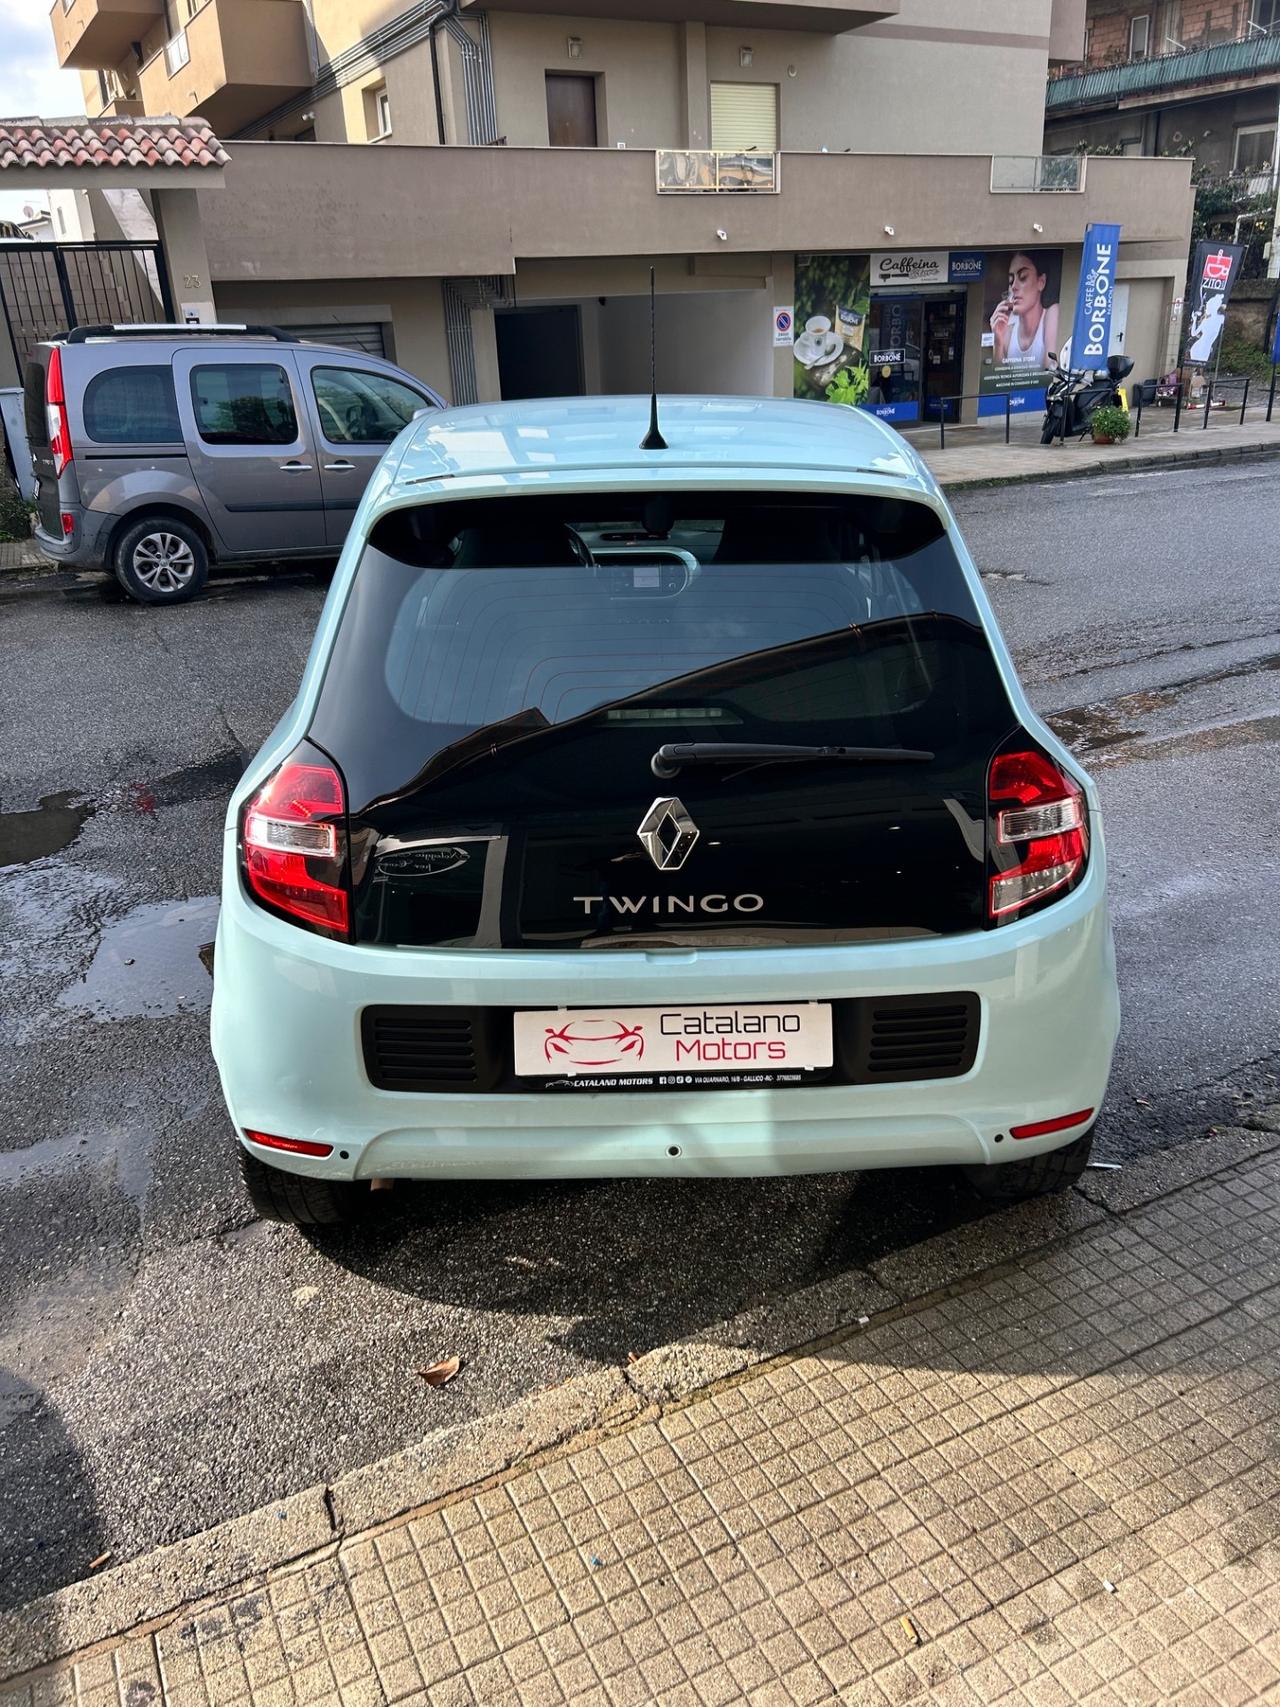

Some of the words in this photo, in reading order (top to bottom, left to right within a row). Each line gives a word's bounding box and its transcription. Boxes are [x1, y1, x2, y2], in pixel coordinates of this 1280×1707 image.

[880, 257, 940, 273] Caffeina
[951, 260, 983, 271] BORBONE
[184, 275, 201, 288] 23
[1202, 277, 1221, 289] ZITO
[1083, 243, 1112, 355] BORBONE
[873, 353, 901, 363] BORBONE
[573, 894, 764, 914] TWINGO
[660, 1010, 801, 1035] Catalano
[676, 1037, 786, 1061] Motors
[574, 1079, 617, 1087] CATALANO
[619, 1077, 653, 1086] MOTORS
